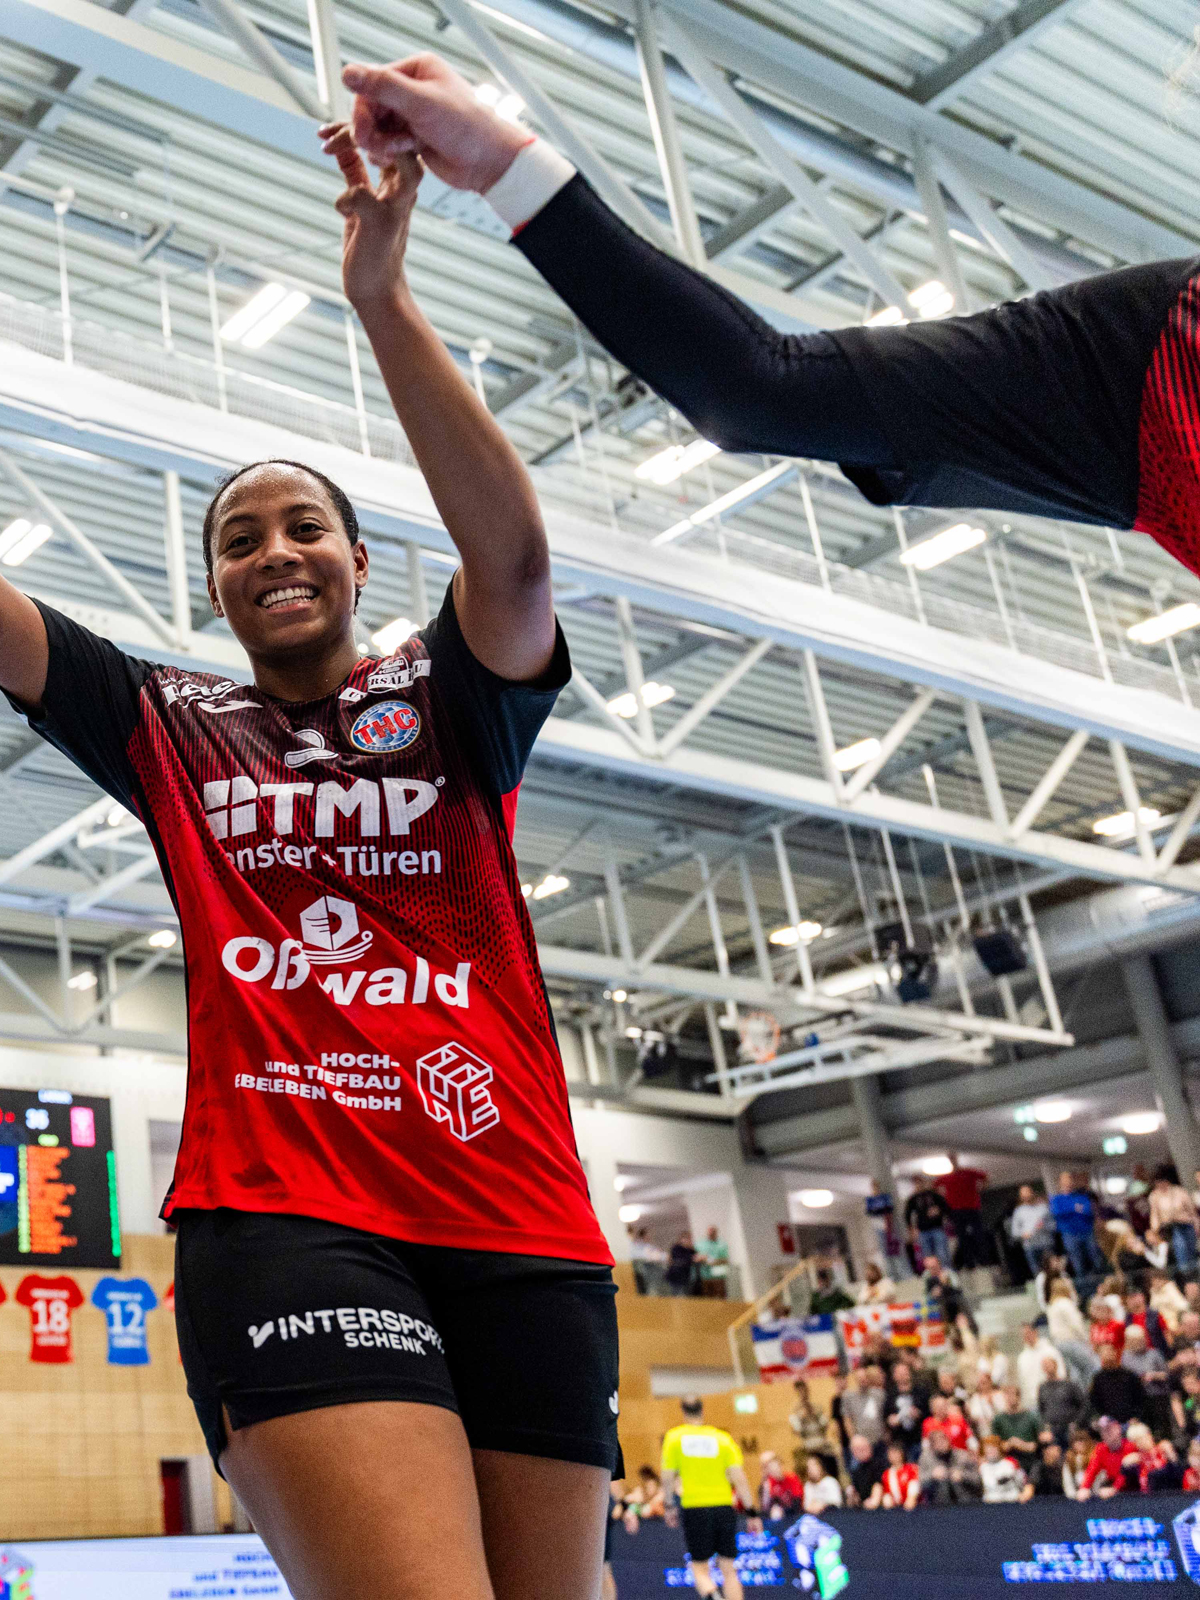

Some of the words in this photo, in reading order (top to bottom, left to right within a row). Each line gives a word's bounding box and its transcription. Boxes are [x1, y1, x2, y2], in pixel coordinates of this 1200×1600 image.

[354, 708, 417, 745] THC
[221, 935, 471, 1009] Oßwald
[265, 1060, 300, 1077] und
[303, 1065, 401, 1090] TIEFBAU
[321, 1052, 400, 1069] HOCH-
[332, 1090, 402, 1111] GmbH
[32, 1300, 70, 1334] 18
[108, 1302, 144, 1335] 12
[344, 1331, 427, 1356] SCHENK
